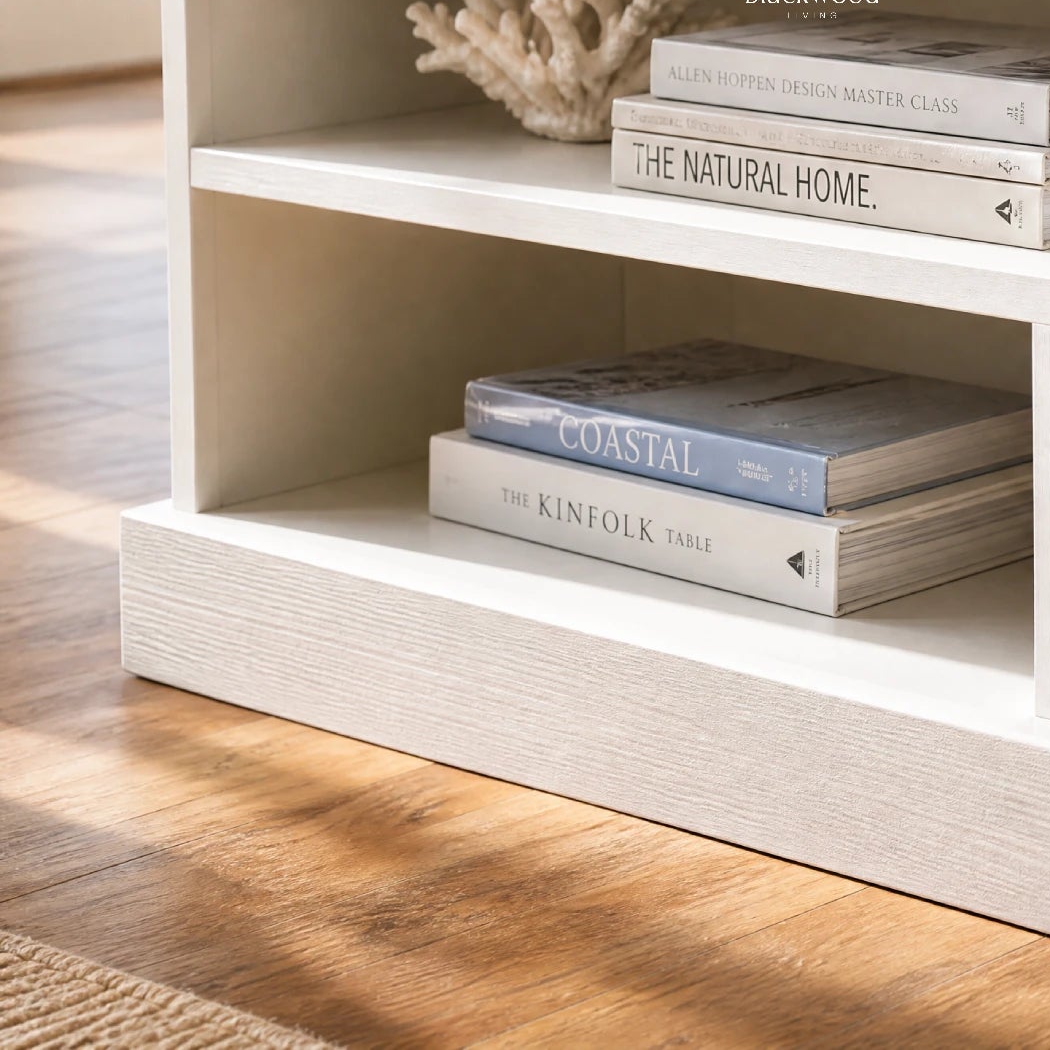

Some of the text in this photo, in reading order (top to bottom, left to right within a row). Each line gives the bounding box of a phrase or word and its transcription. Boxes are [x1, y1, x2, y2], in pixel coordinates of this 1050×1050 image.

[667, 66, 959, 114] ALLEN HOPPEN DESIGN MASTER CLASS
[633, 142, 877, 210] THE NATURAL HOME.
[559, 415, 699, 477] COASTAL
[501, 487, 713, 554] THE KINFOLK TABLE
